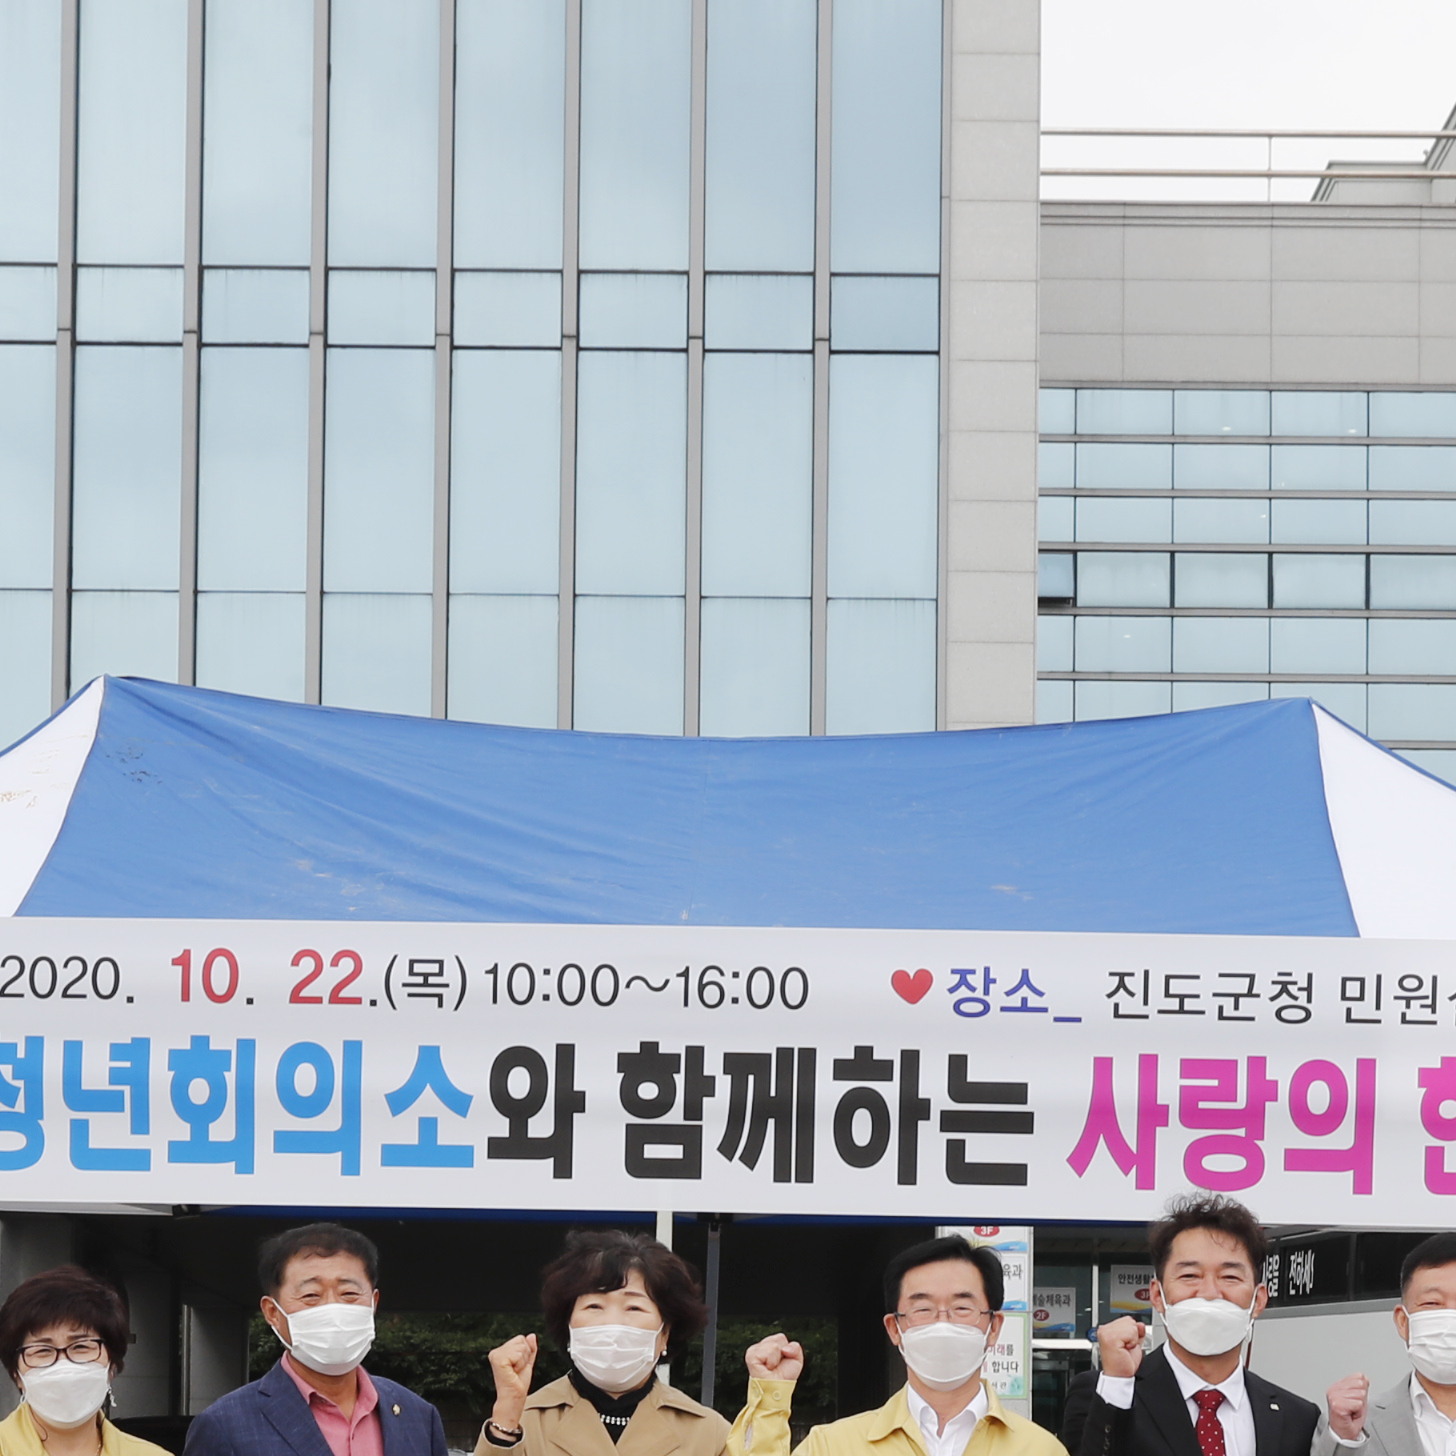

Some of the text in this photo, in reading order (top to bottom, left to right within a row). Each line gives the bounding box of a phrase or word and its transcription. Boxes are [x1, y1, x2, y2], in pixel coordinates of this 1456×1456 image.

[0, 955, 134, 1004] 2020.
[171, 948, 254, 1004] 10.
[946, 966, 1082, 1023] 장소_
[1105, 969, 1313, 1025] 진도군청
[616, 1041, 1036, 1187] 함께하는
[1066, 1054, 1376, 1196] 사랑의
[1036, 1312, 1047, 1320] 2F
